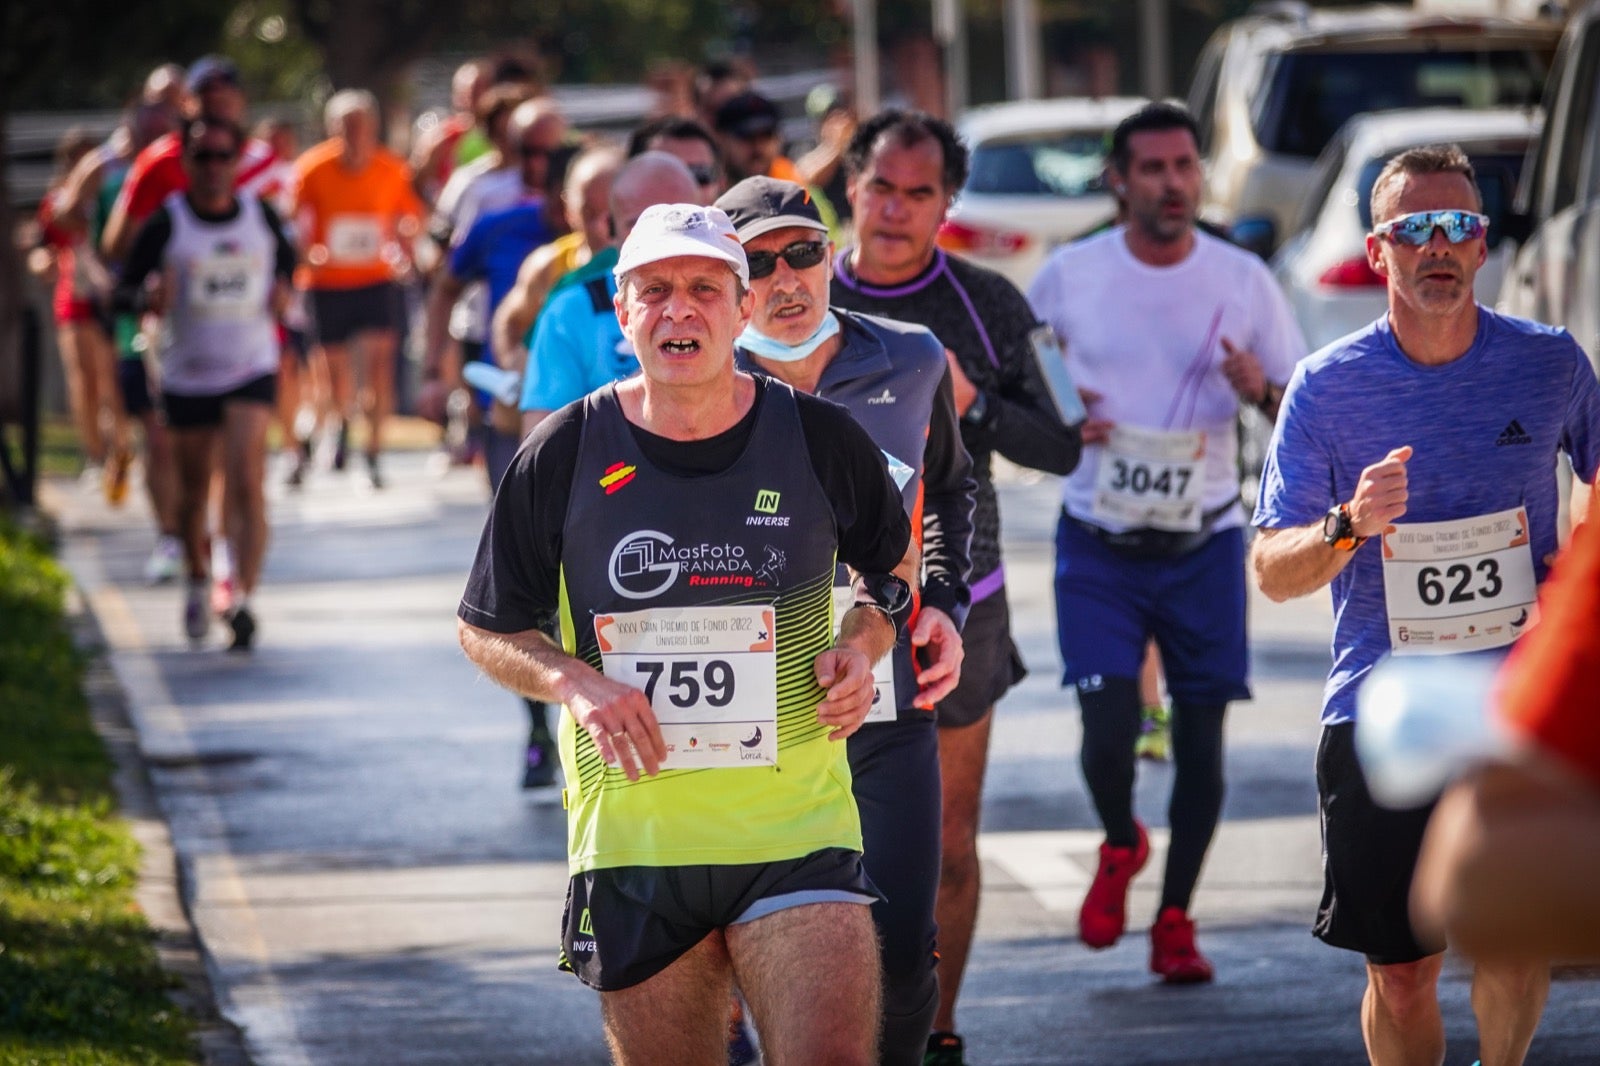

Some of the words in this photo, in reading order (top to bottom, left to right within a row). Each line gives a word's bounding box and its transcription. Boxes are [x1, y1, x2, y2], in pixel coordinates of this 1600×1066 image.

[1495, 436, 1532, 447] adidas
[1110, 458, 1192, 497] 3047
[757, 493, 778, 510] IN
[745, 516, 790, 527] INVERSE
[659, 543, 745, 561] MasFoto
[1417, 558, 1503, 606] 623
[730, 617, 753, 631] 2022
[636, 659, 735, 708] 759
